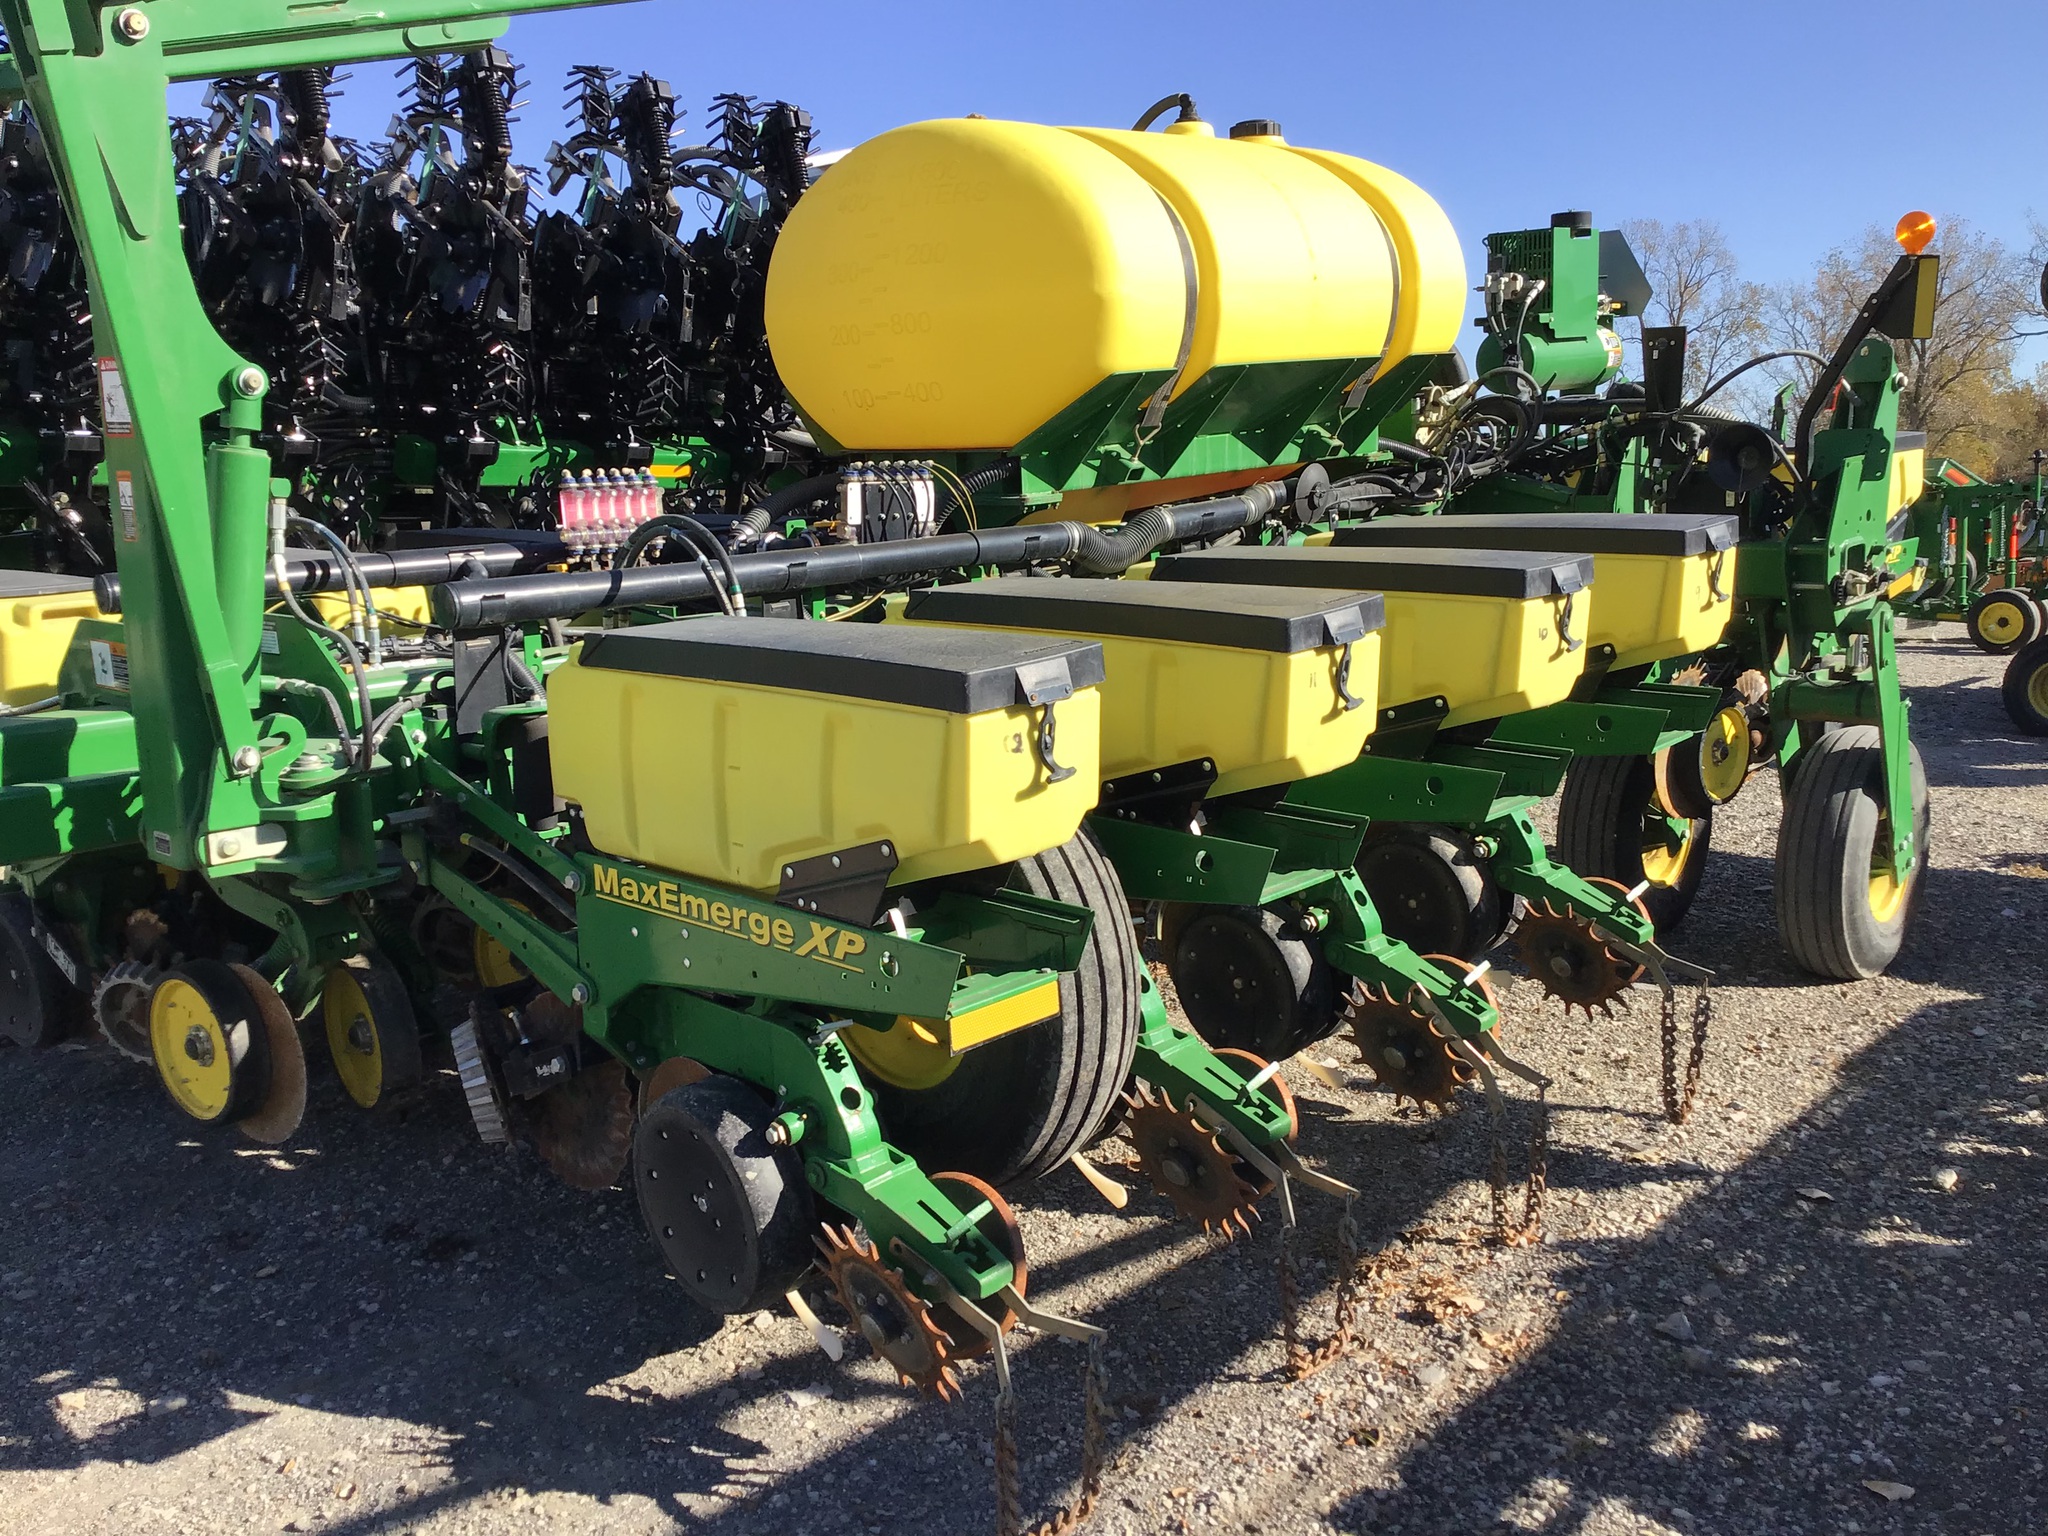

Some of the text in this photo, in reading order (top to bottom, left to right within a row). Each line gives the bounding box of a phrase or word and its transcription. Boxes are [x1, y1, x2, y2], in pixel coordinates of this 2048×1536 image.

[898, 180, 993, 208] LITERS
[892, 241, 950, 266] 1200
[828, 323, 862, 347] 200
[889, 311, 932, 336] 800
[841, 386, 876, 409] 100
[902, 380, 945, 403] 400
[592, 863, 867, 962] MaxEmerge XP
